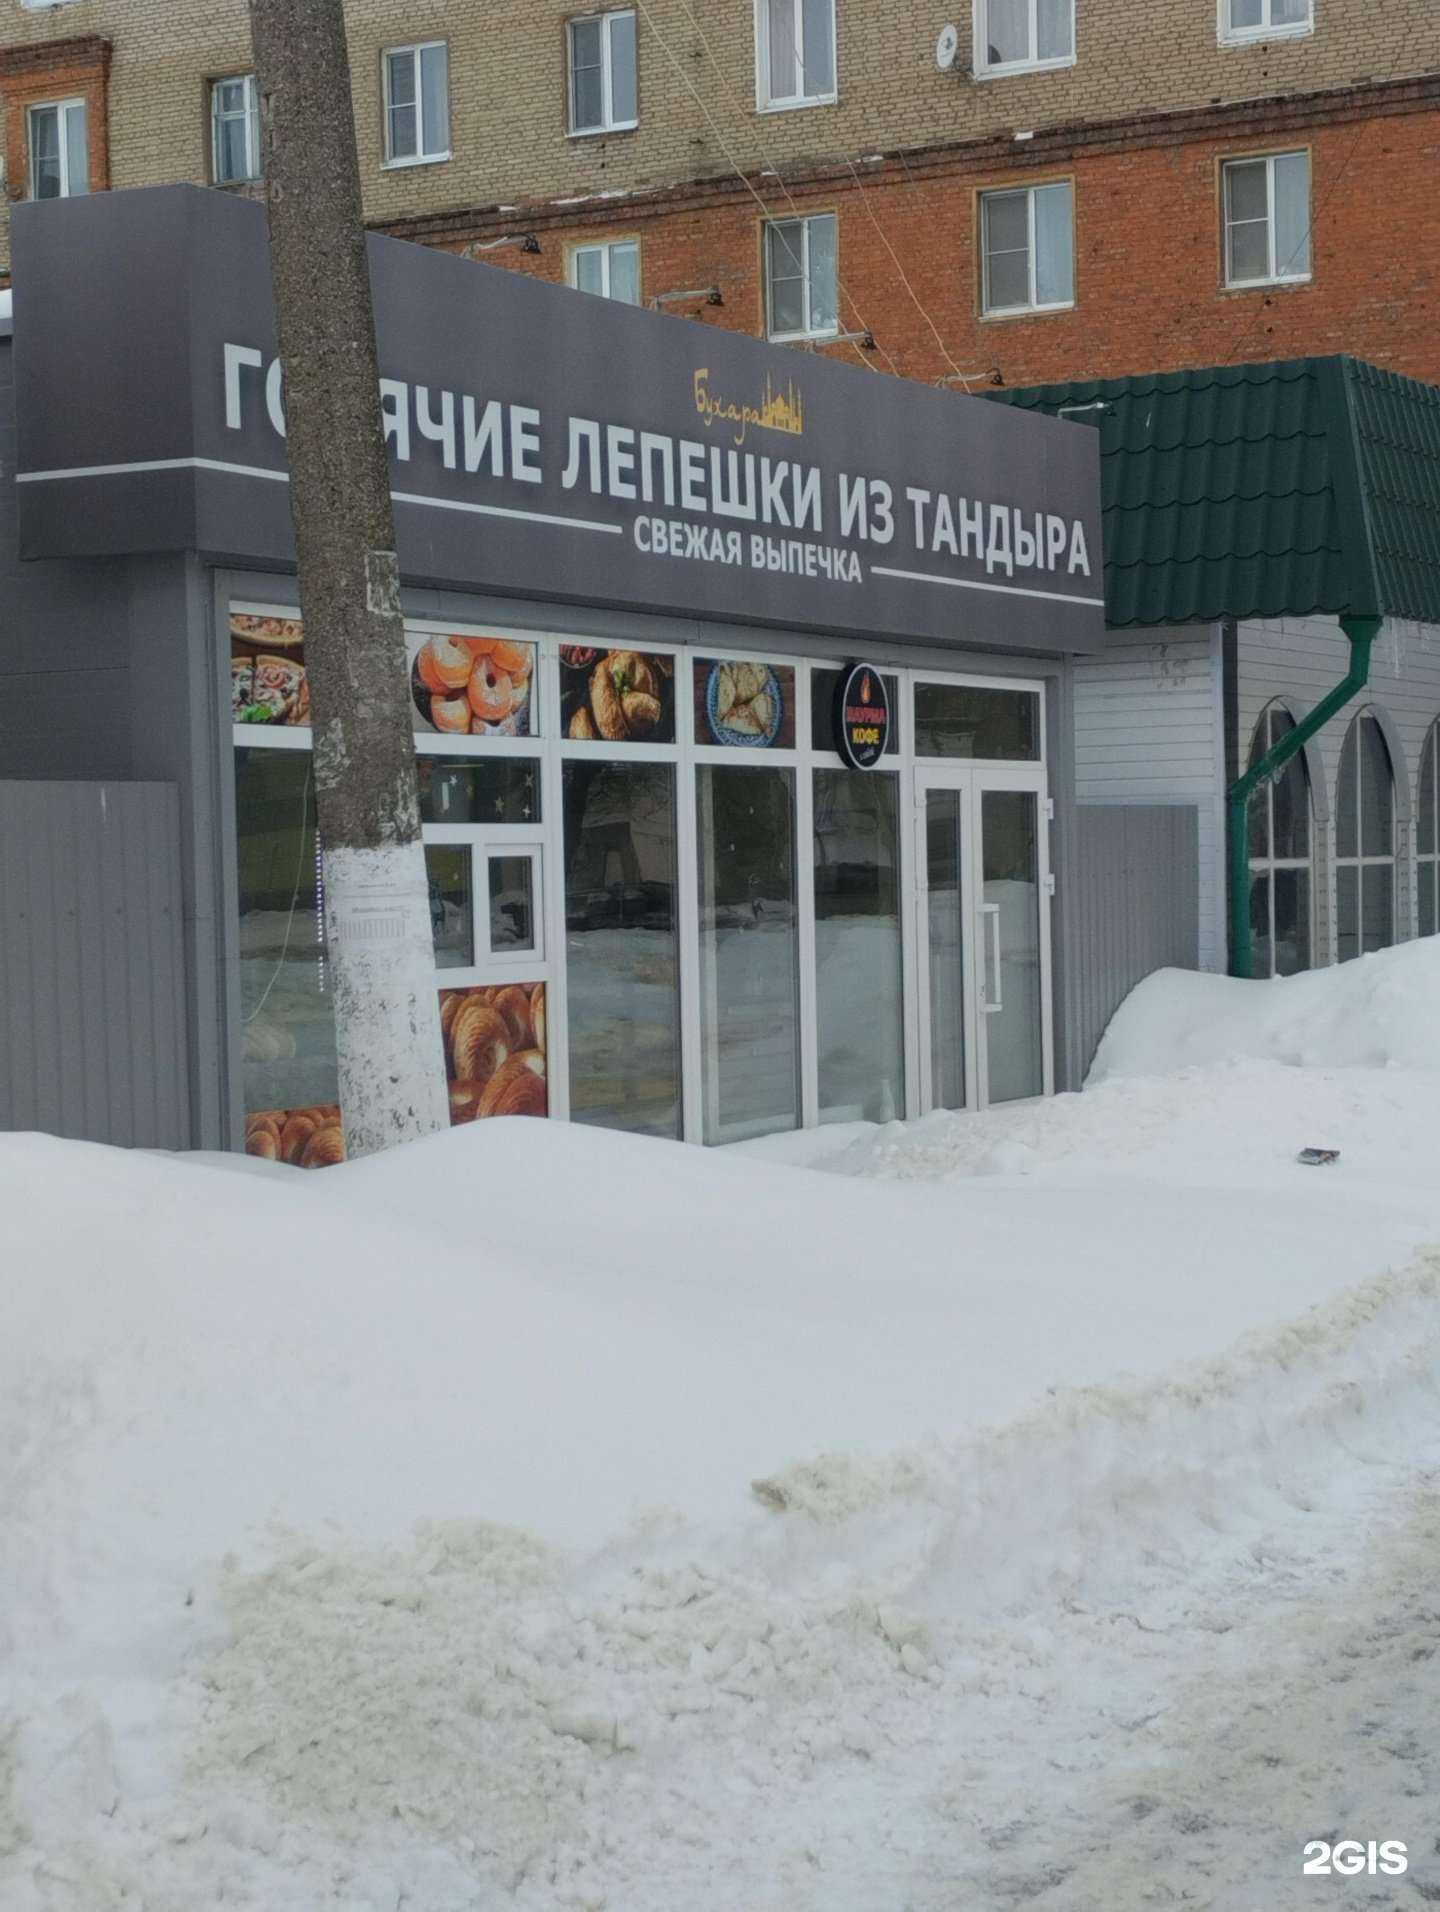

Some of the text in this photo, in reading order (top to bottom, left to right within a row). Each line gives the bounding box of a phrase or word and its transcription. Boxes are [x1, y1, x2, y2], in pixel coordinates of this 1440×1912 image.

[693, 367, 762, 446] Бухара
[223, 343, 1091, 577] ГЯЧИЕ ЛЕПЕШКИ ИЗ ТАНДЫРА
[633, 515, 863, 583] СВЕЖАЯ ВЫПЕЧКА
[852, 727, 880, 745] КОФЕ
